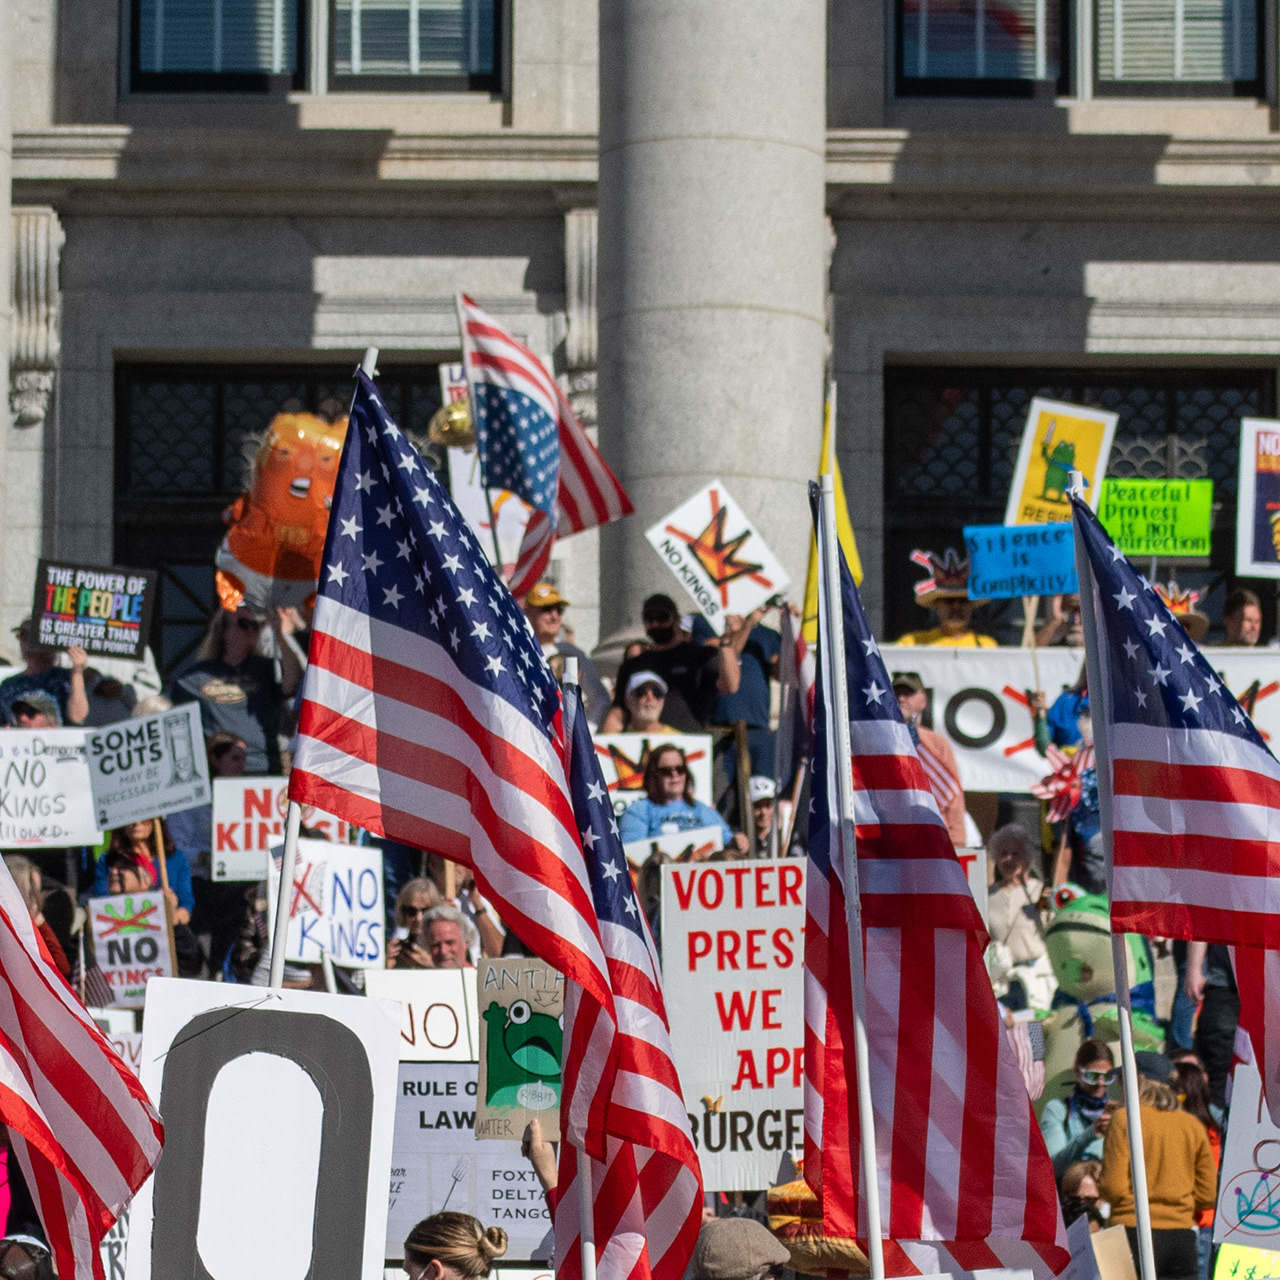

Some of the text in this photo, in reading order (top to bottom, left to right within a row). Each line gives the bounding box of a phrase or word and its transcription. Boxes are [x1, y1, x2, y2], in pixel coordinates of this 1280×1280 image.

[1107, 484, 1190, 503] Peaceful
[969, 531, 1066, 553] Silence
[1012, 551, 1028, 566] is
[48, 567, 147, 595] THE POWER OF
[660, 539, 719, 616] NO KINGS
[46, 584, 144, 622] THE PEOPLE
[40, 619, 139, 644] IS GREATER THAN
[40, 633, 55, 645] THE
[91, 720, 160, 756] SOME
[100, 742, 163, 775] CUTS
[5, 760, 46, 787] NO
[120, 767, 160, 783] MAY BE
[98, 781, 162, 807] NECESSARY
[332, 868, 378, 915] NO
[107, 936, 159, 965] NO
[104, 967, 164, 987] KINGS
[714, 989, 782, 1032] WE
[403, 1081, 458, 1097] RULE
[520, 1089, 555, 1103] RIBBIT
[419, 1111, 477, 1130] LAW
[477, 1119, 514, 1137] WATER
